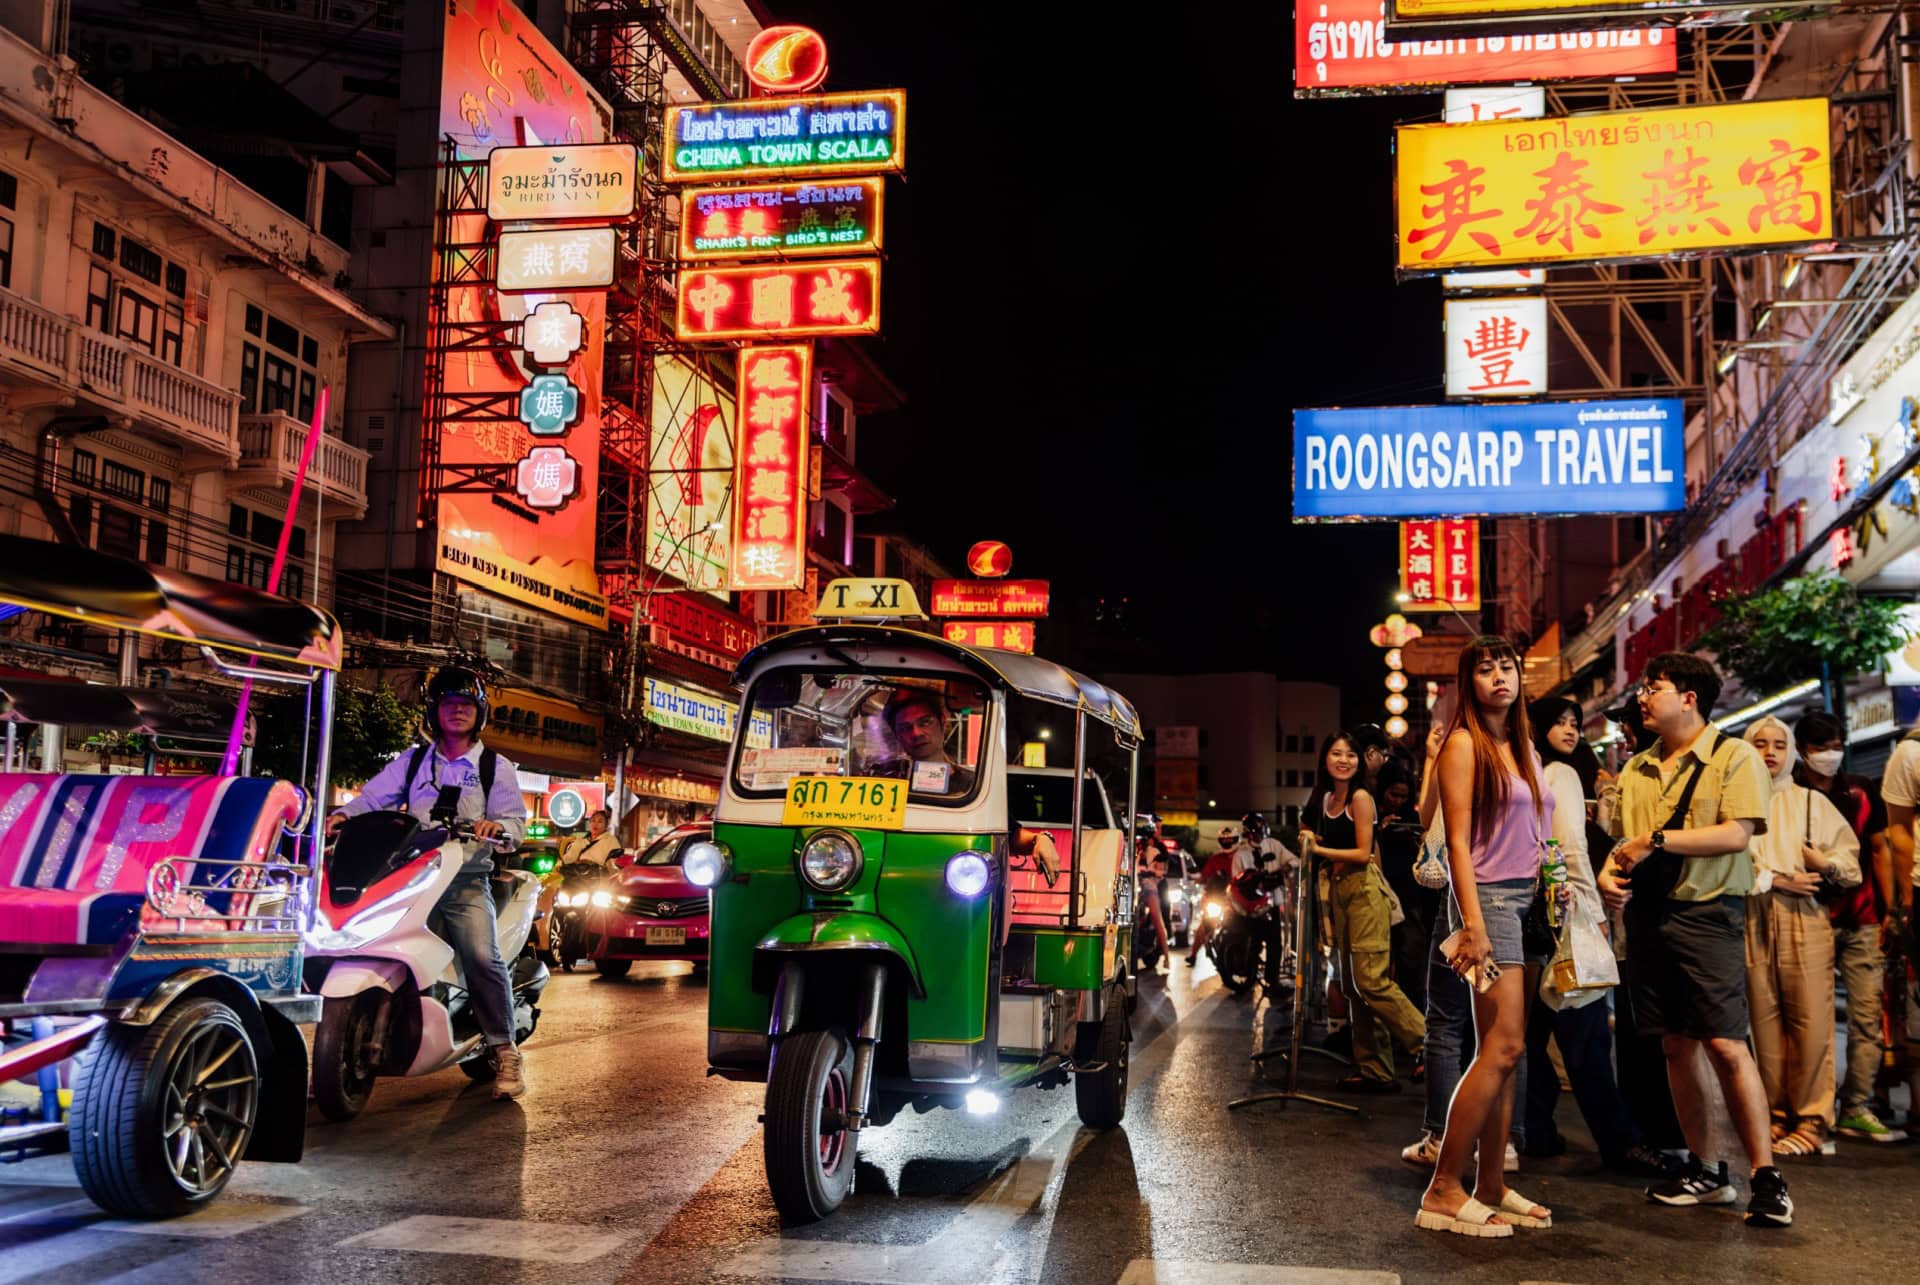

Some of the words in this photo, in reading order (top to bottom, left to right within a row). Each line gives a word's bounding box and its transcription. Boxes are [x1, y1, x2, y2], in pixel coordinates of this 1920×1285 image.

[1504, 117, 1715, 153] เอกไทยรังนก
[676, 147, 743, 168] CHINA
[748, 143, 812, 164] TOWN
[817, 138, 889, 159] SCALA
[519, 192, 556, 202] BIRD
[830, 229, 864, 242] NEST
[1463, 315, 1531, 392] 豐
[536, 390, 564, 419] 媽
[1304, 430, 1525, 491] ROONGSARP
[1534, 424, 1674, 485] TRAVEL
[533, 462, 561, 491] 媽
[648, 678, 727, 727] ไชน่าทาวน์
[647, 711, 670, 726] CHINA
[672, 715, 694, 731] TOWN
[839, 781, 898, 808] 7161
